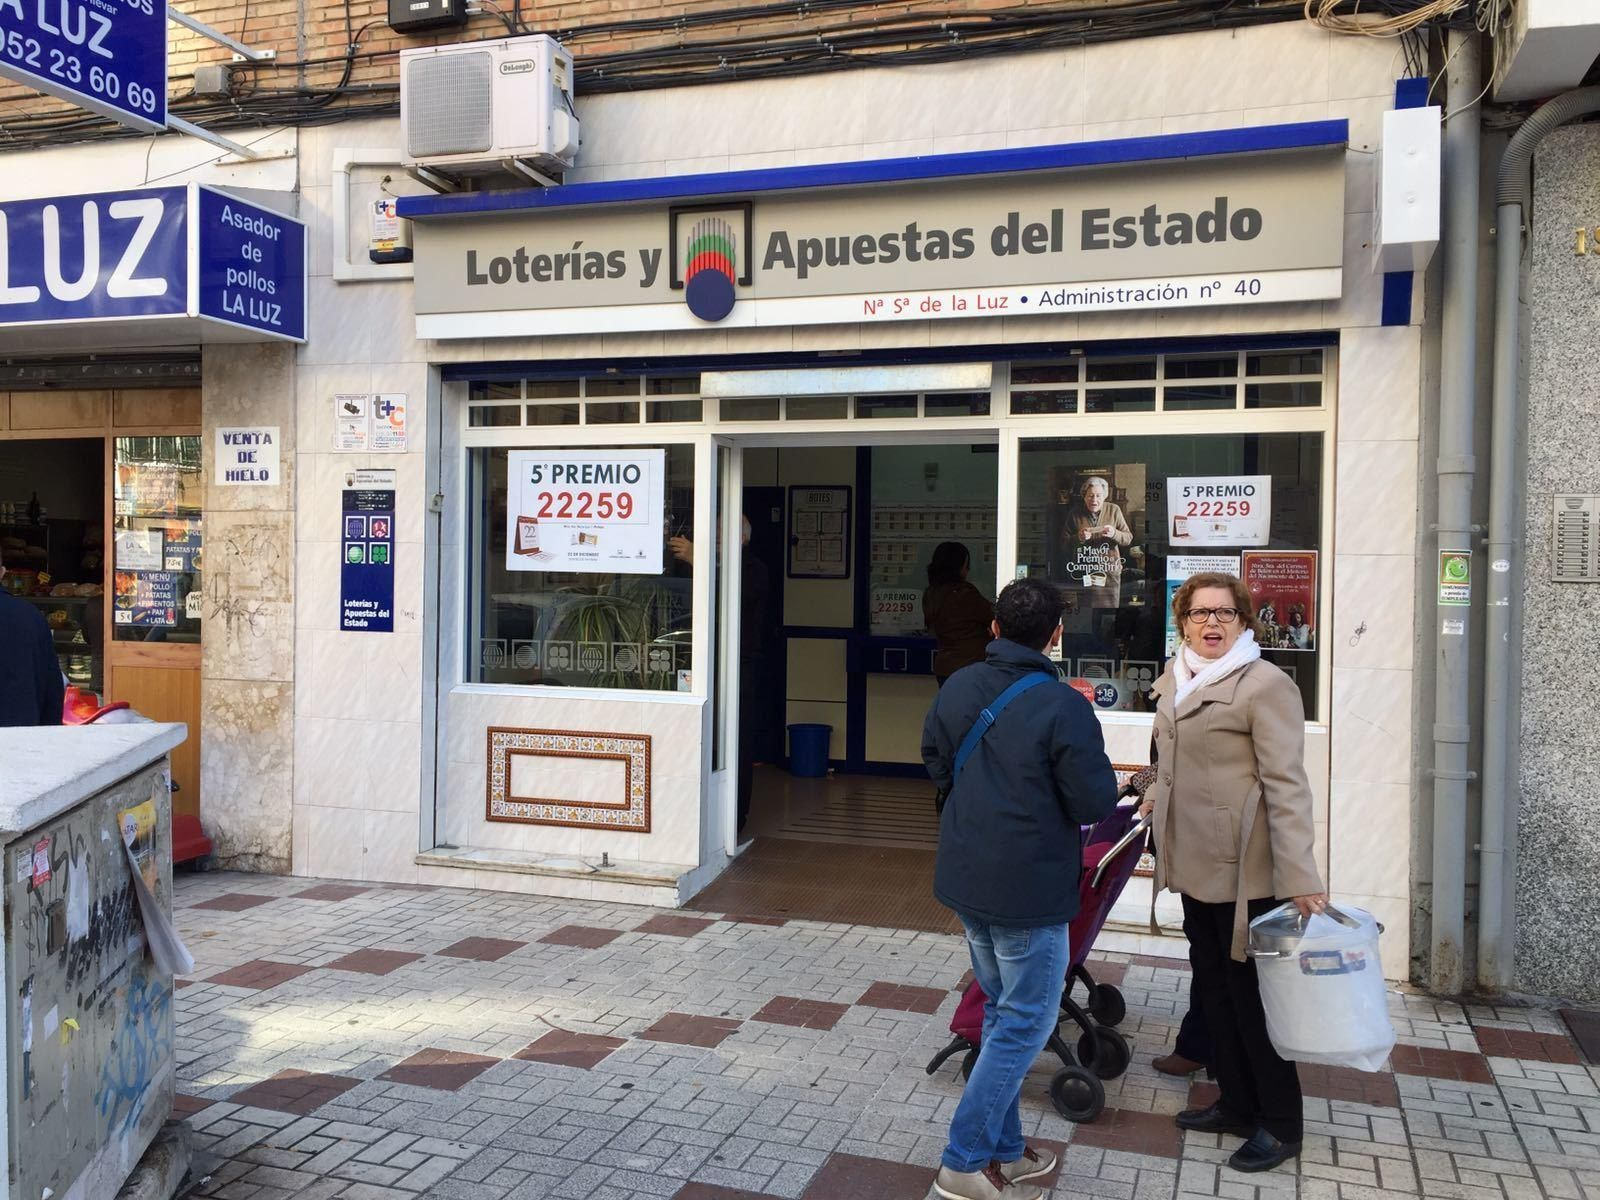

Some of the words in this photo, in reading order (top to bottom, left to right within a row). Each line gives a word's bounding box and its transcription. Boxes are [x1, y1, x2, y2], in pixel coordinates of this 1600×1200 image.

[37, 0, 114, 59] LUZ
[50, 49, 82, 83] 23
[89, 66, 120, 99] 60
[127, 82, 156, 113] 69
[221, 205, 282, 241] Asador
[466, 240, 627, 287] Loterías
[639, 247, 663, 289] y
[761, 220, 976, 281] Apuestas
[990, 208, 1065, 257] del
[1080, 195, 1263, 251] Estado
[0, 197, 168, 305] LUZ
[241, 240, 262, 263] de
[226, 267, 276, 295] pollos
[863, 298, 885, 315] Nª
[893, 297, 910, 314] Sª
[919, 296, 942, 313] de
[951, 294, 968, 311] la
[976, 294, 1010, 311] Luz
[1039, 281, 1189, 308] Administración
[1199, 280, 1222, 299] nº
[1233, 278, 1262, 297] 40
[223, 289, 245, 317] LA
[249, 297, 282, 326] LUZ
[223, 430, 273, 446] VENTA
[237, 449, 258, 464] DE
[225, 467, 270, 482] HIELO
[552, 463, 642, 485] PREMIO
[1196, 485, 1256, 498] PREMIO
[537, 491, 634, 520] 22259
[1186, 500, 1251, 517] 22259
[1083, 544, 1110, 556] Mayor
[1077, 553, 1110, 565] Premio
[343, 599, 373, 608] Loterías
[373, 601, 379, 610] y
[883, 593, 917, 601] PREMIO
[344, 608, 377, 619] Apuestas
[378, 609, 390, 618] del
[879, 602, 914, 613] 22259
[343, 618, 369, 628] Estado
[1096, 688, 1115, 699] +18
